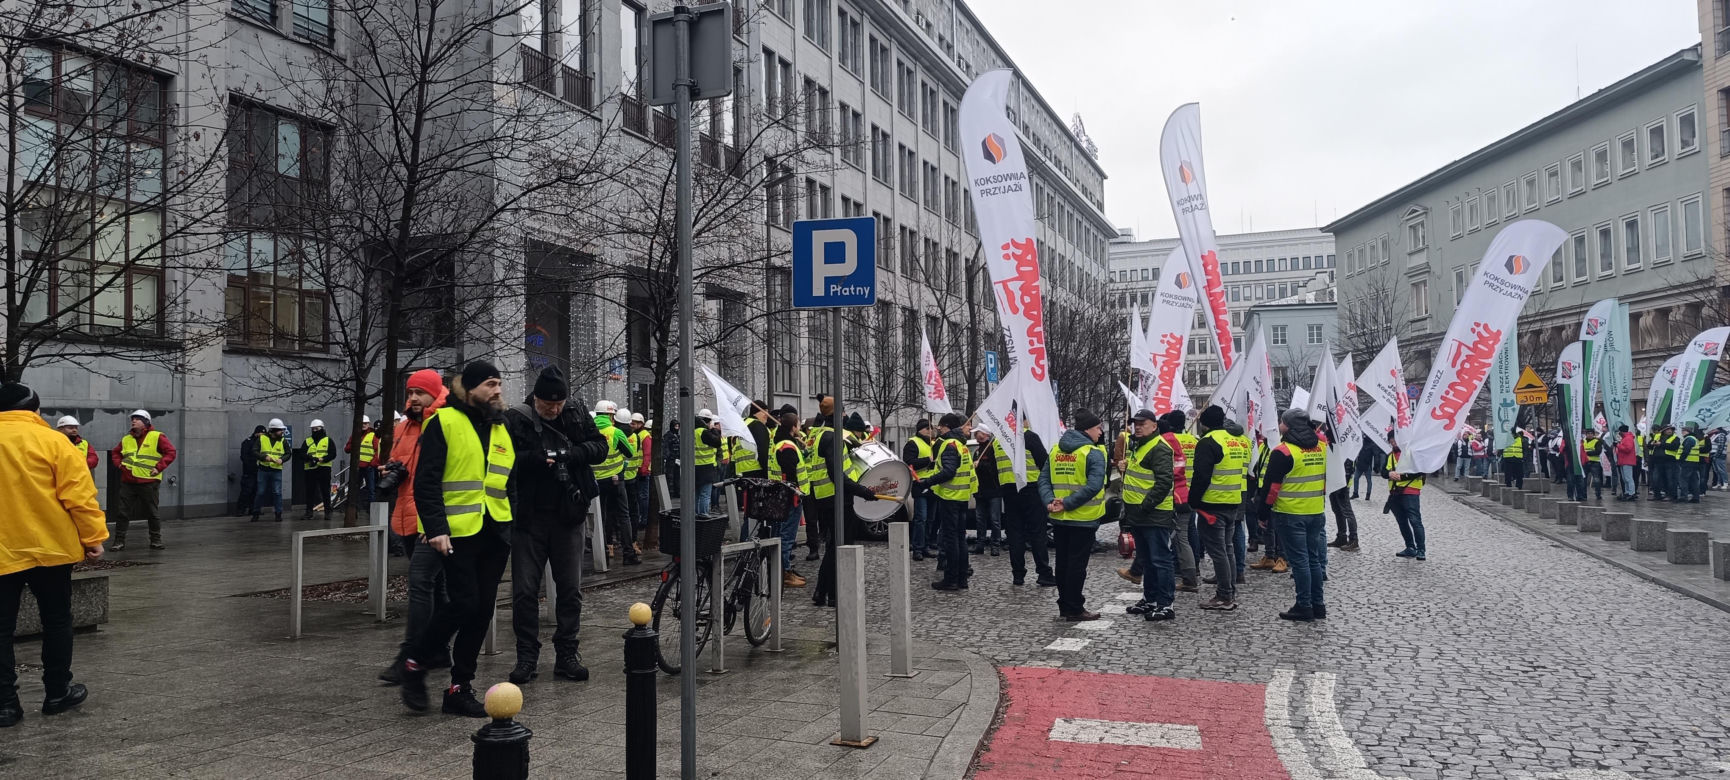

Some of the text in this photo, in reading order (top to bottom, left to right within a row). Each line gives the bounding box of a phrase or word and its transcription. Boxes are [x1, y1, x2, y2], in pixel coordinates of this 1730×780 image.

[974, 171, 1027, 188] KOKSOWNIA
[812, 228, 858, 297] P
[830, 284, 871, 299] Płatny
[1483, 270, 1530, 296] KOKSOWNIA
[987, 353, 995, 373] P
[1431, 321, 1503, 431] Solidarność
